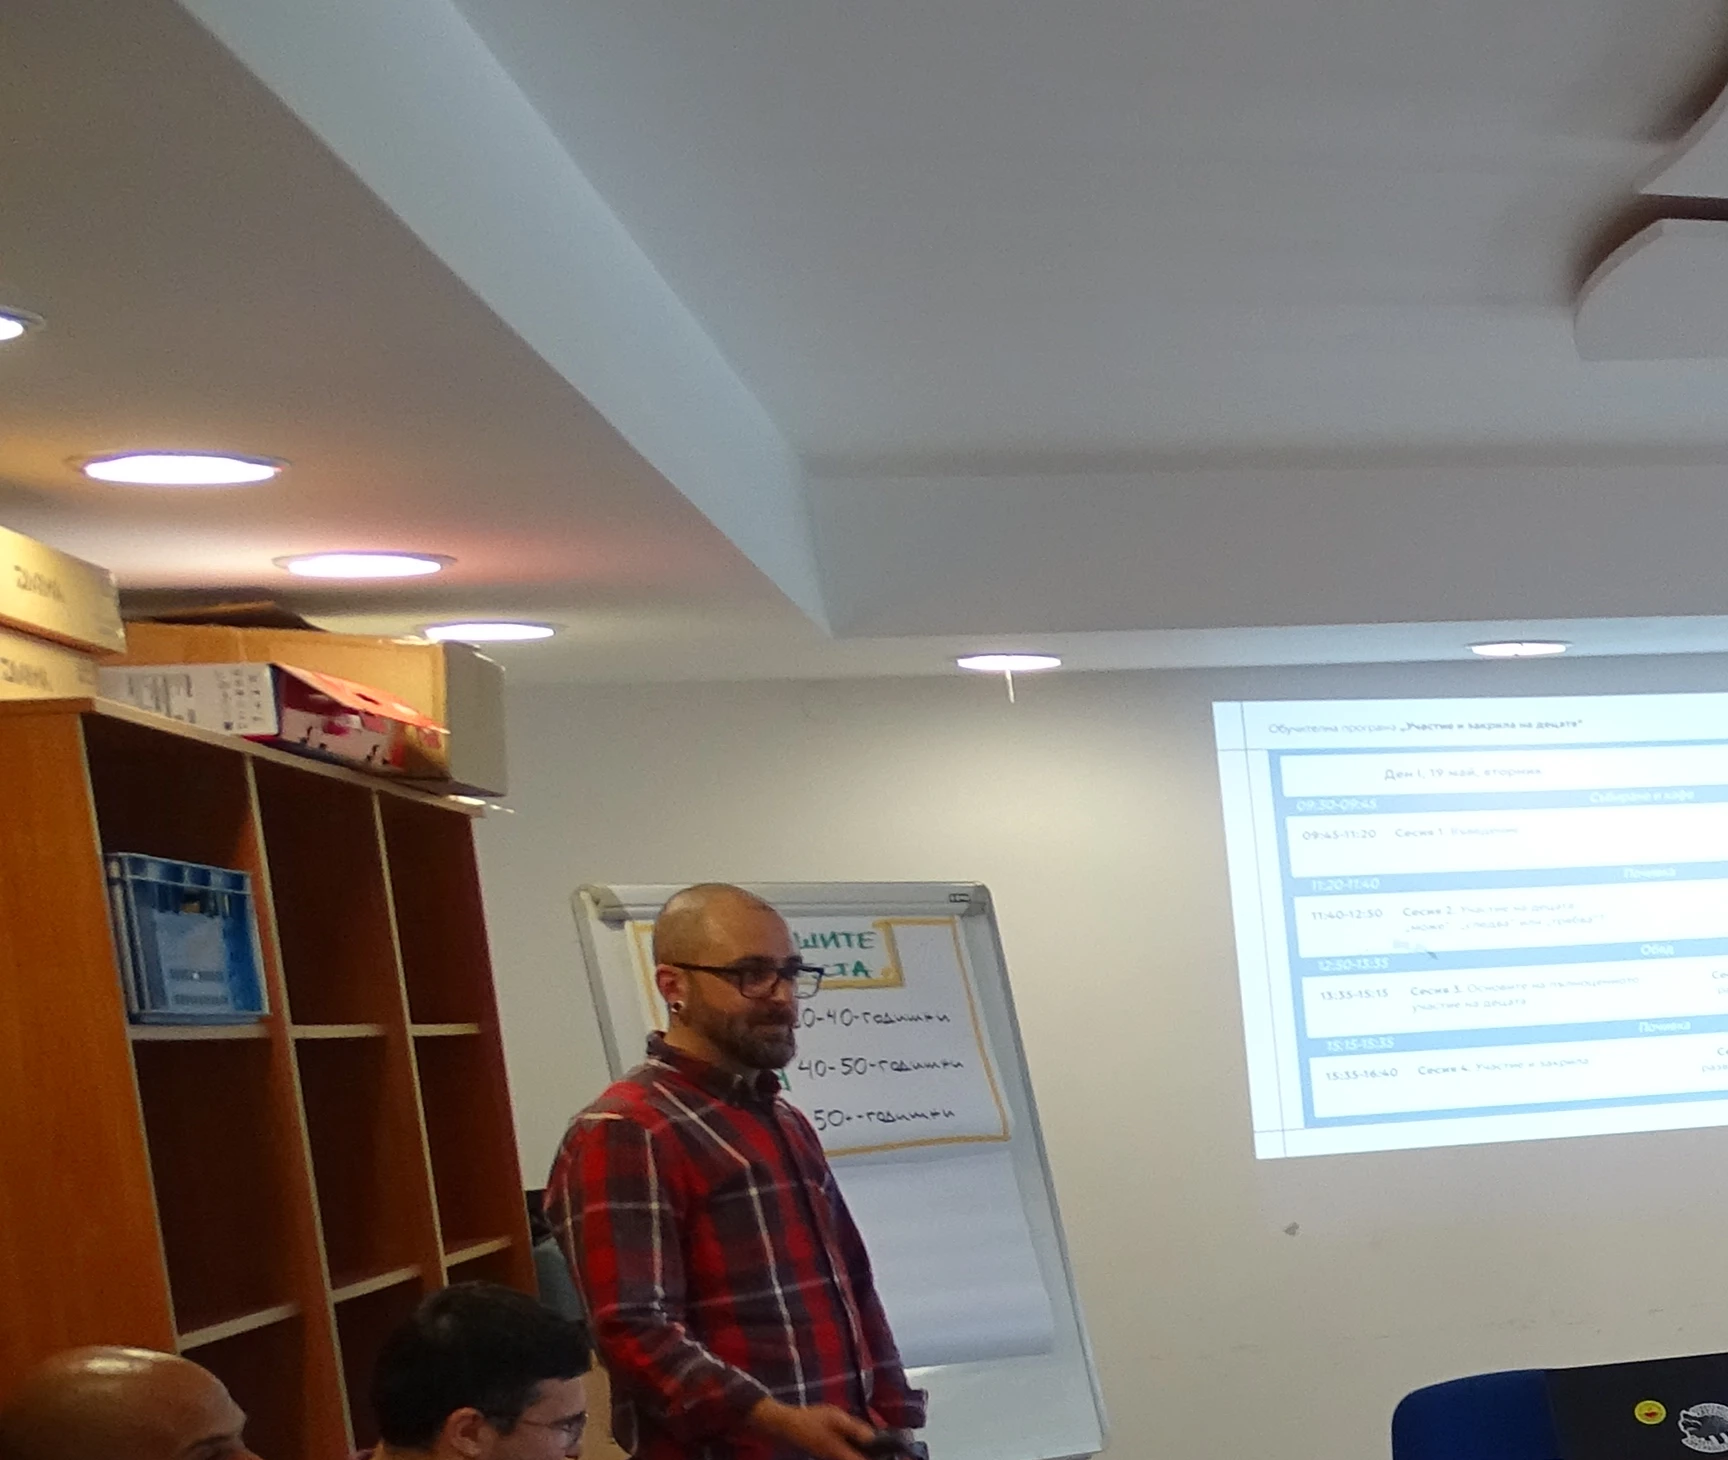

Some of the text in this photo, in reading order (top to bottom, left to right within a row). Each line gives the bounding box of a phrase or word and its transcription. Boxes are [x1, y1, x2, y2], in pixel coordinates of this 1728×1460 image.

[1384, 767, 1413, 781] Ден
[1302, 827, 1377, 841] 09:45-11:20
[1394, 826, 1434, 838] Сесия
[1402, 906, 1441, 918] Сесия
[792, 930, 877, 950] ШИТЕ
[1410, 985, 1450, 997] Сесия
[1418, 1064, 1457, 1076] Сесия
